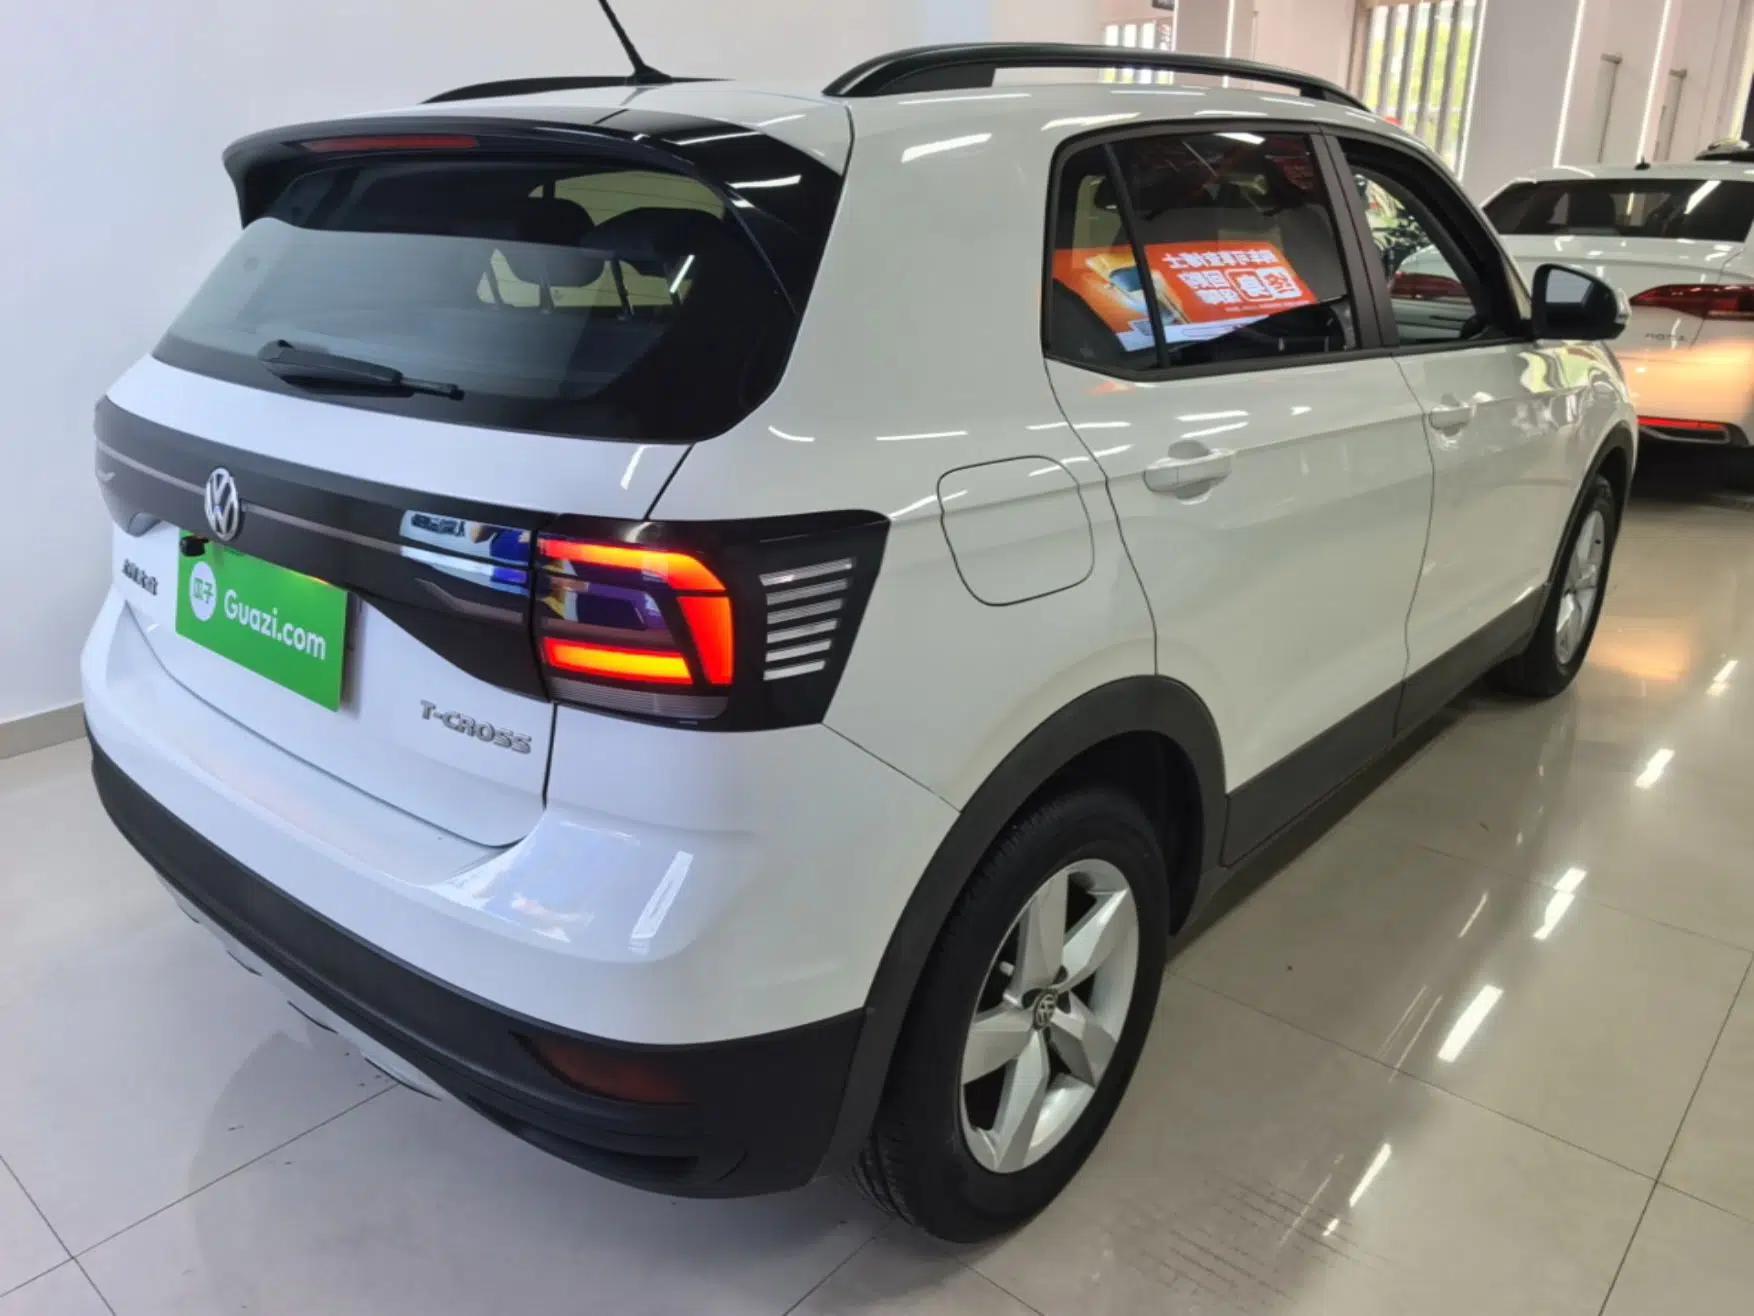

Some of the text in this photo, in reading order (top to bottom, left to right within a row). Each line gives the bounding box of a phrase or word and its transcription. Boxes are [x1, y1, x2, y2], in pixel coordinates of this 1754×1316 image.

[204, 467, 240, 542] VW
[223, 589, 327, 661] Guazi.com
[420, 700, 532, 755] T-CROSS
